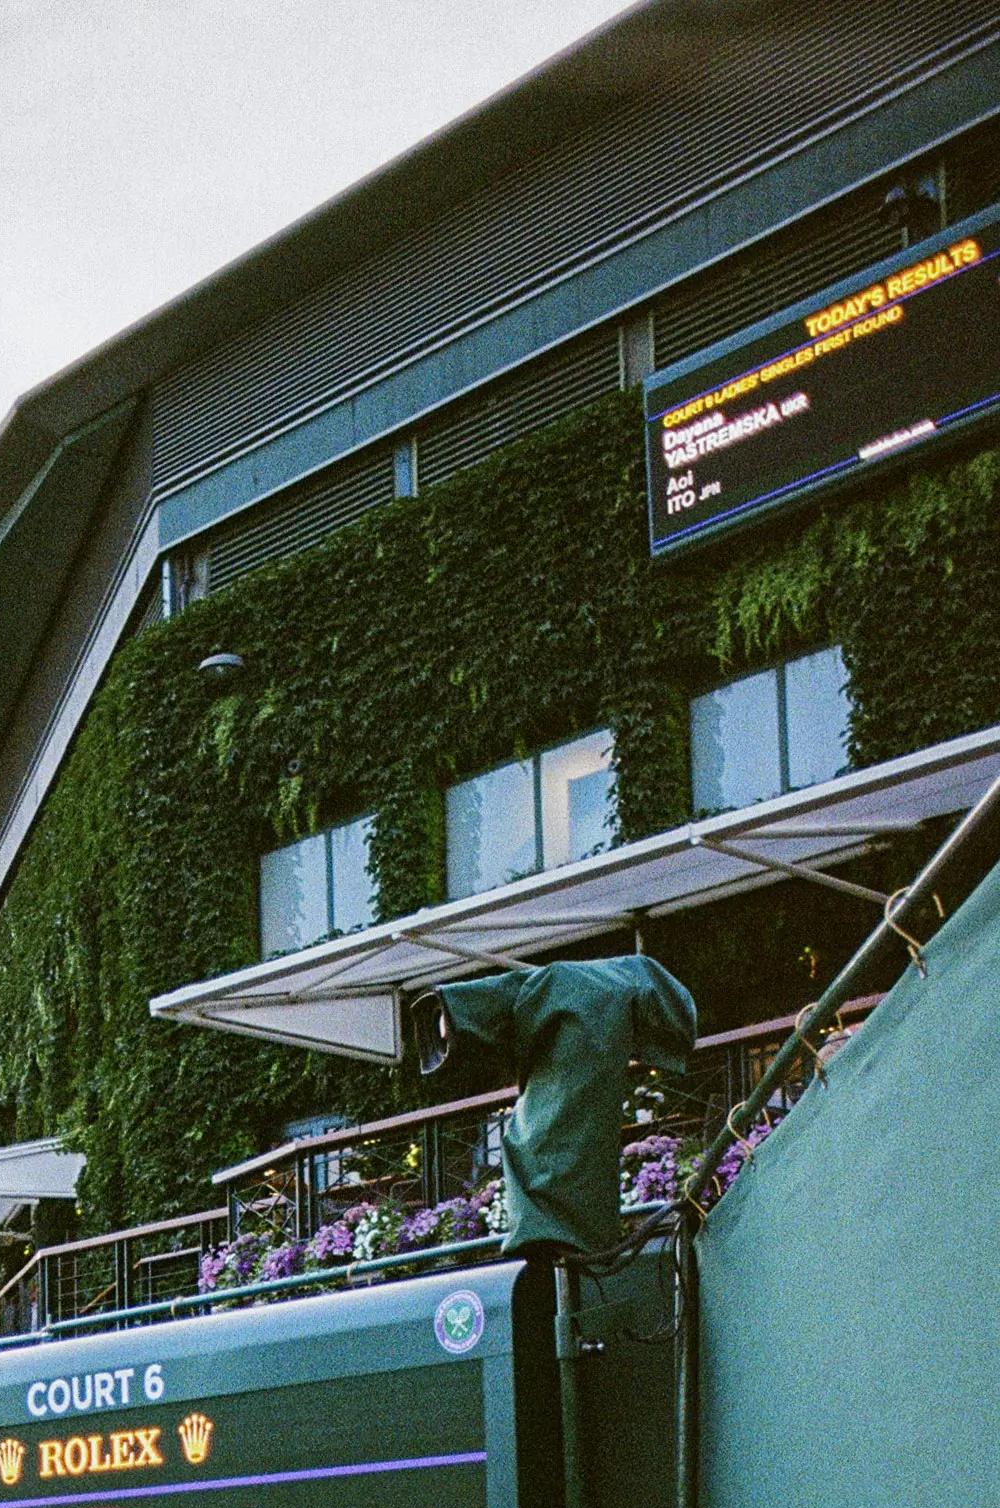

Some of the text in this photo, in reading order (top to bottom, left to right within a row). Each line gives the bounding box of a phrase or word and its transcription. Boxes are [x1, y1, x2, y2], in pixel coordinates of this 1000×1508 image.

[805, 238, 979, 337] TODAY'S RESULTS
[663, 395, 705, 428] COURT
[759, 346, 815, 382] SINGLES
[814, 327, 853, 357] FIRST
[851, 304, 904, 339] ROUND
[663, 411, 725, 450] Dayana
[663, 401, 783, 469] YASTREMSKA
[666, 469, 694, 496] Aoi
[667, 480, 722, 515] ITO JPN
[27, 1364, 165, 1416] COURT 6
[38, 1427, 163, 1479] ROLEX
